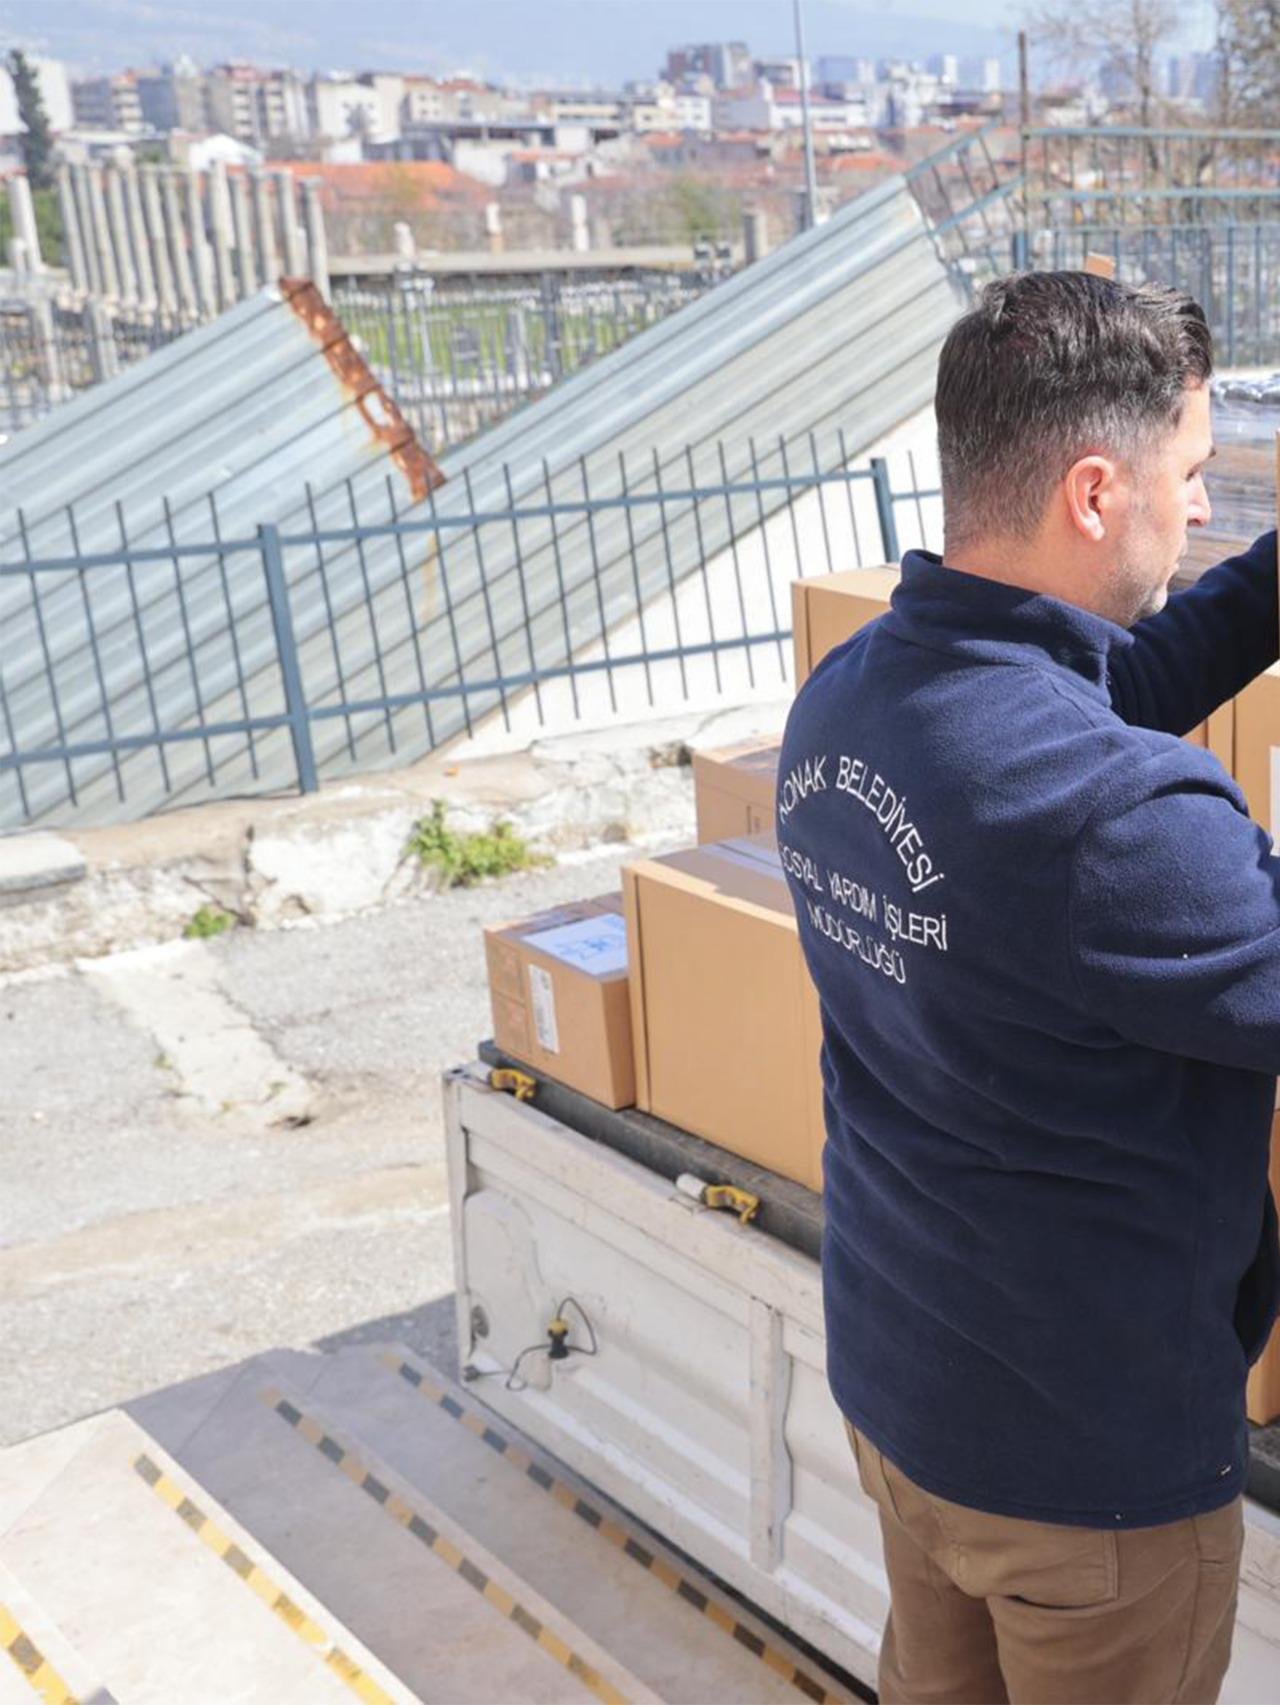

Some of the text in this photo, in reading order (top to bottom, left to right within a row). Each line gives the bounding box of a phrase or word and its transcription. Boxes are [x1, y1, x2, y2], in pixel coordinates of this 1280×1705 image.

[835, 755, 945, 893] BELEDİYESİ
[806, 899, 906, 984] MÜDÜRLÜĞÜ
[827, 868, 877, 922] YARDIM
[882, 894, 948, 951] İŞLERİ
